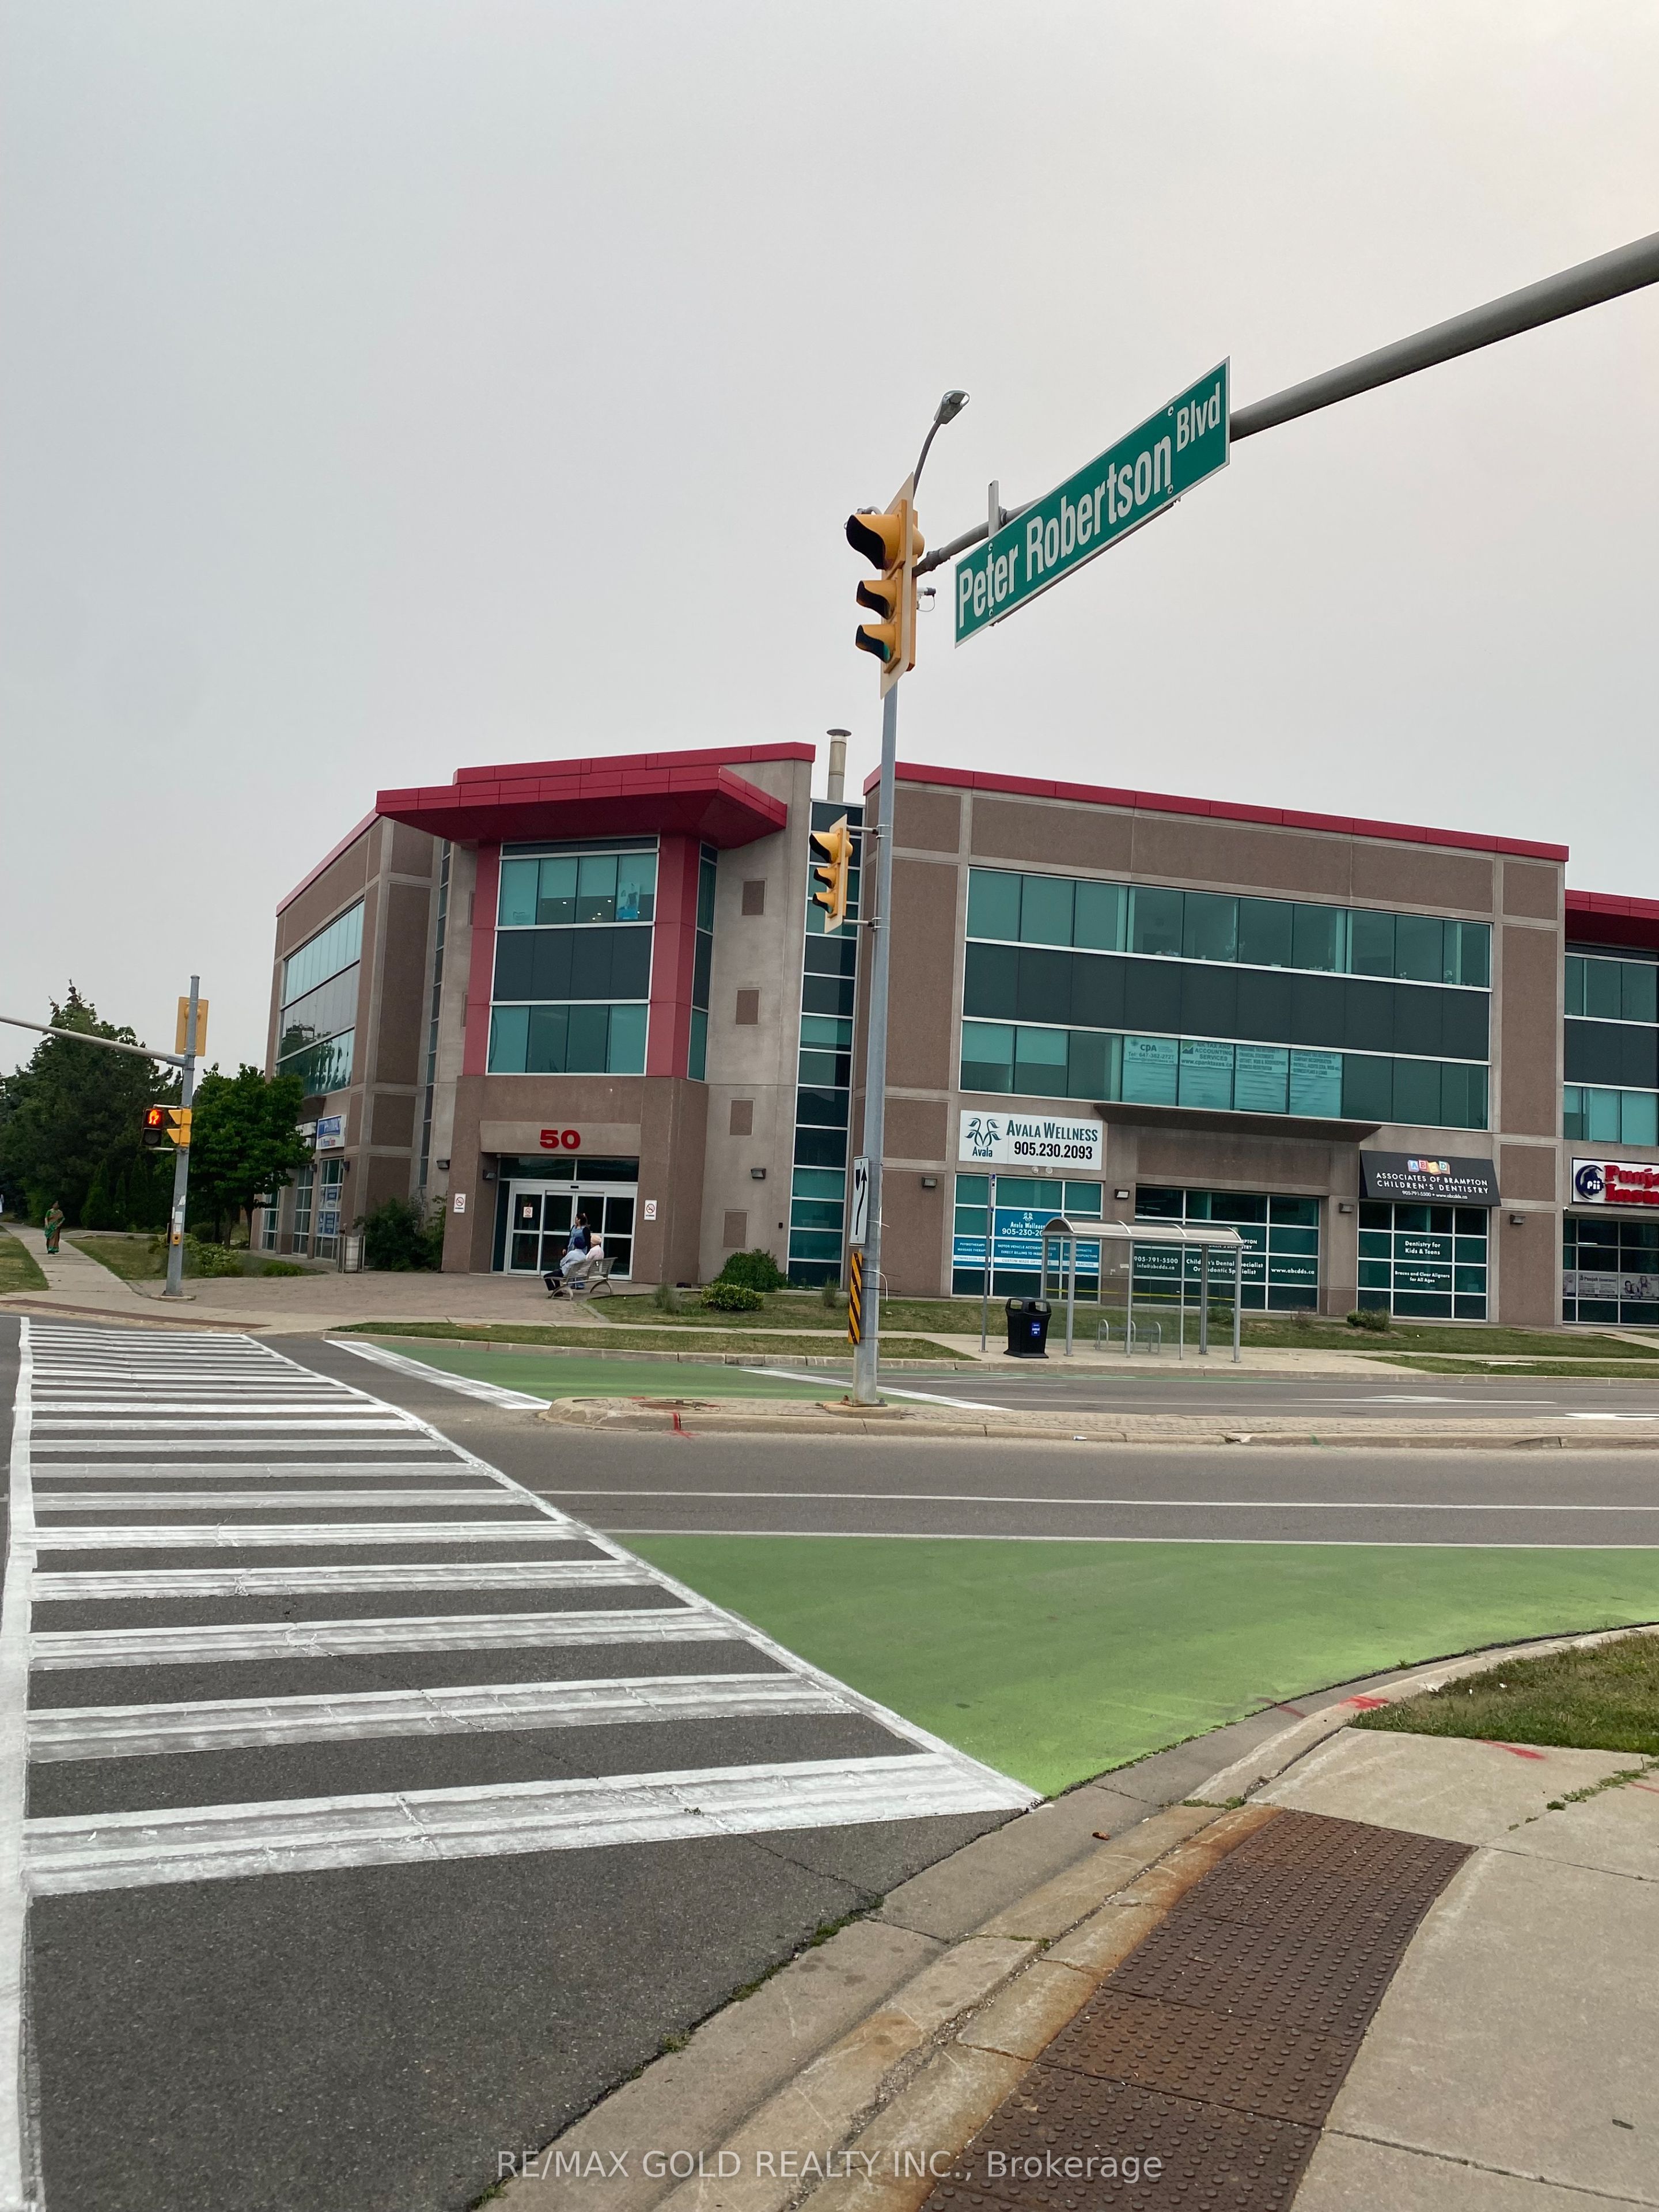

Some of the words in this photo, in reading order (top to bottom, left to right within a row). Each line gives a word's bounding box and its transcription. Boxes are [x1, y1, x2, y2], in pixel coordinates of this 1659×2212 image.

[959, 544, 1018, 628] Peter
[1026, 434, 1172, 582] Robertson
[1177, 382, 1221, 453] Blvd
[1006, 1120, 1041, 1138] AVALA
[1044, 1122, 1098, 1142] WELLNESS
[539, 1129, 581, 1150] 50
[972, 1146, 993, 1157] Avala
[1014, 1141, 1093, 1160] 905.230.2093
[1376, 1172, 1426, 1182] ASSOCIATES
[1444, 1177, 1488, 1186] BRAMPTON
[1377, 1180, 1434, 1190] CHILDREN'S
[1439, 1184, 1488, 1194] DENTISTRY
[1002, 1228, 1043, 1236] 905-230-20
[1405, 1240, 1431, 1248] Dentistry
[1134, 1256, 1179, 1264] 905-791-5500
